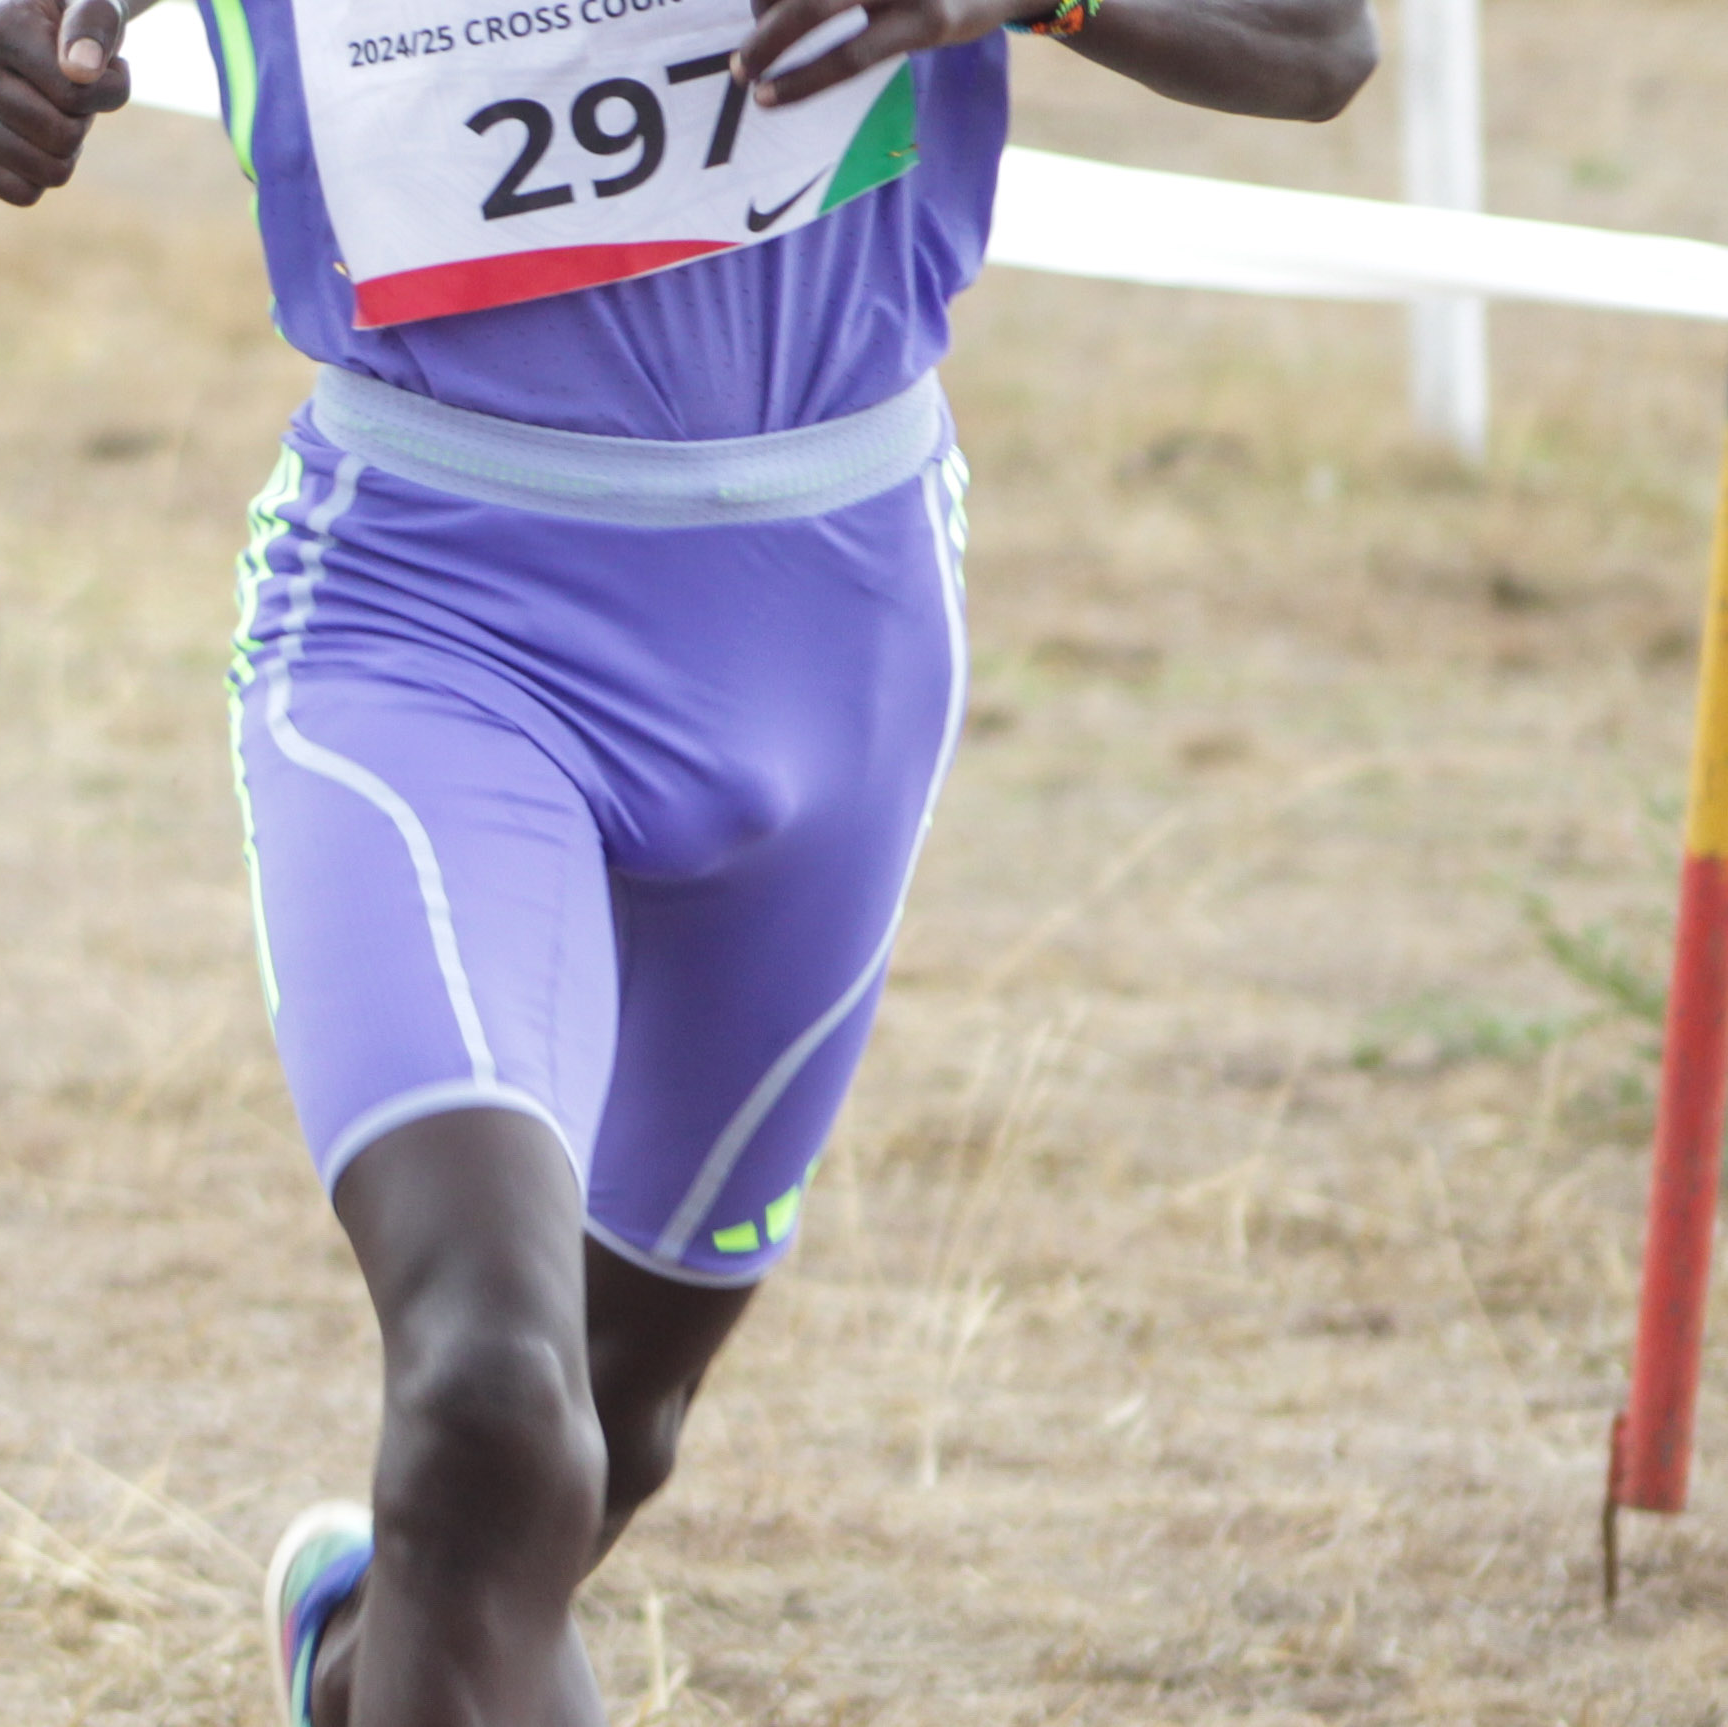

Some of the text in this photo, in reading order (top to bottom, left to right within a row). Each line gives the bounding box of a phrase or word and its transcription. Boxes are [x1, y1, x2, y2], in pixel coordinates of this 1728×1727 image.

[348, 26, 455, 68] 2024/25
[464, 5, 571, 46] CROSS
[464, 49, 749, 221] 297
